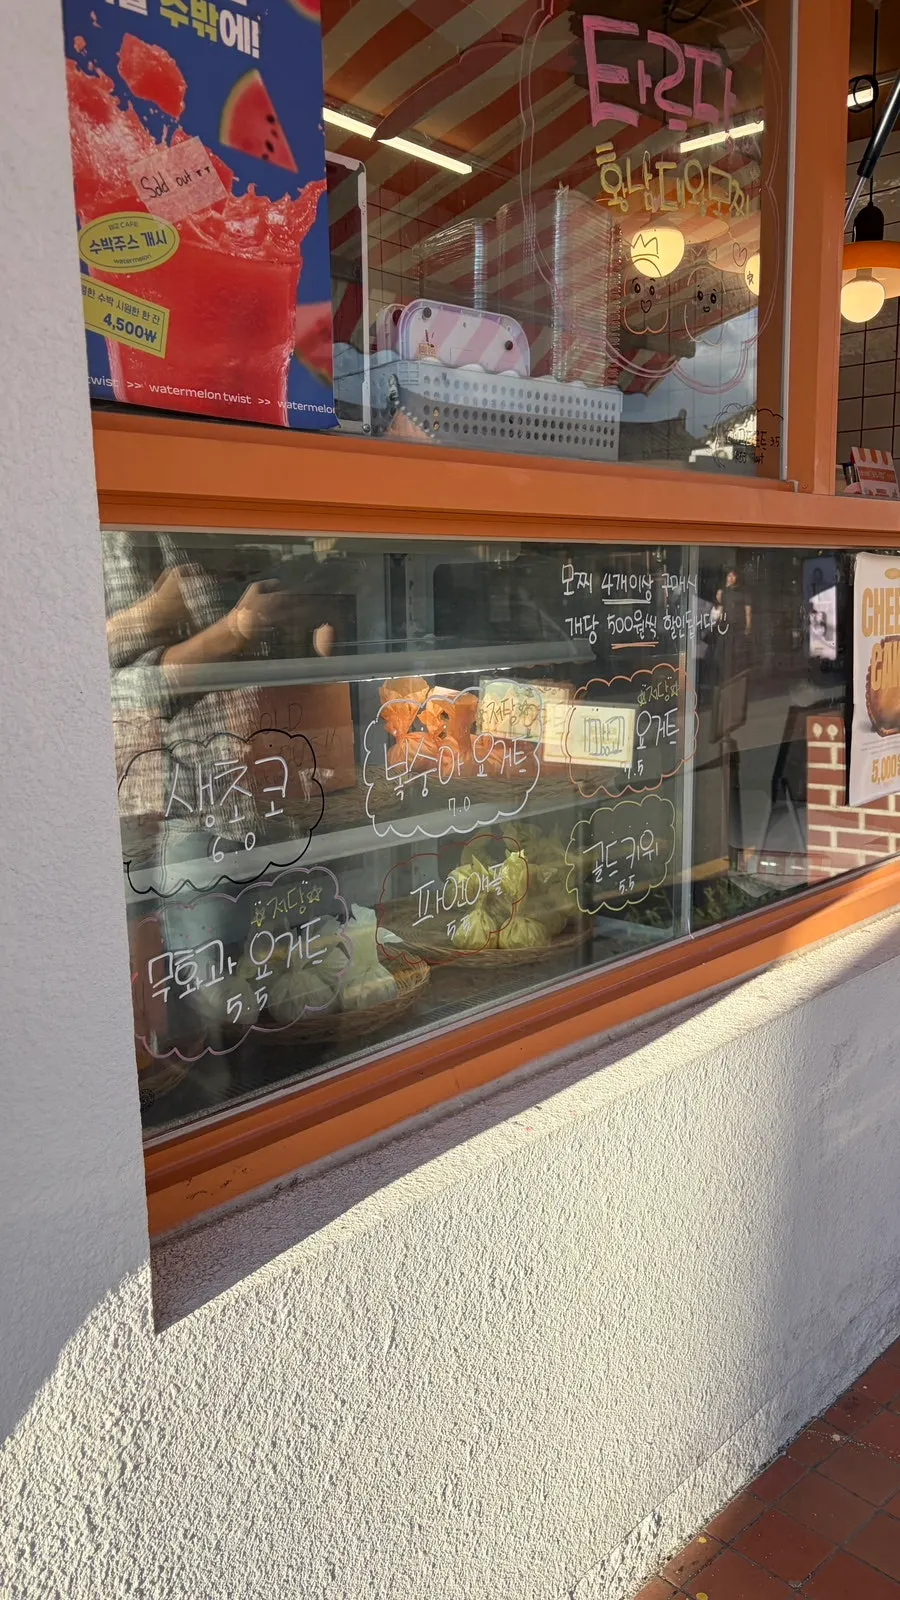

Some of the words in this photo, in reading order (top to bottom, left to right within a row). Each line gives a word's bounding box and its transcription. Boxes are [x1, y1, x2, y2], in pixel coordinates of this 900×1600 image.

[175, 168, 193, 187] out
[89, 234, 140, 255] 수박주스
[140, 229, 168, 247] 개시
[97, 292, 114, 307] 수박
[115, 299, 140, 318] 시원한
[142, 310, 150, 322] 한
[151, 313, 160, 326] 잔
[149, 384, 222, 400] watermelon
[223, 392, 252, 405] twist
[561, 563, 593, 596] 모찌
[601, 572, 654, 602] 4개이상
[564, 614, 600, 644] 개당
[607, 609, 657, 640] 500원씩
[636, 707, 680, 750] 요거트
[383, 737, 464, 800] 복숭아
[473, 732, 531, 777] 요거트
[165, 755, 289, 828] 생초코
[212, 831, 256, 863] 6.0
[582, 829, 659, 883] 골드키위
[409, 862, 506, 927] 파인애플
[618, 874, 636, 895] 5.5
[148, 939, 237, 1003] 무화과
[249, 917, 327, 980] 요거트
[226, 986, 269, 1024] 5.5
